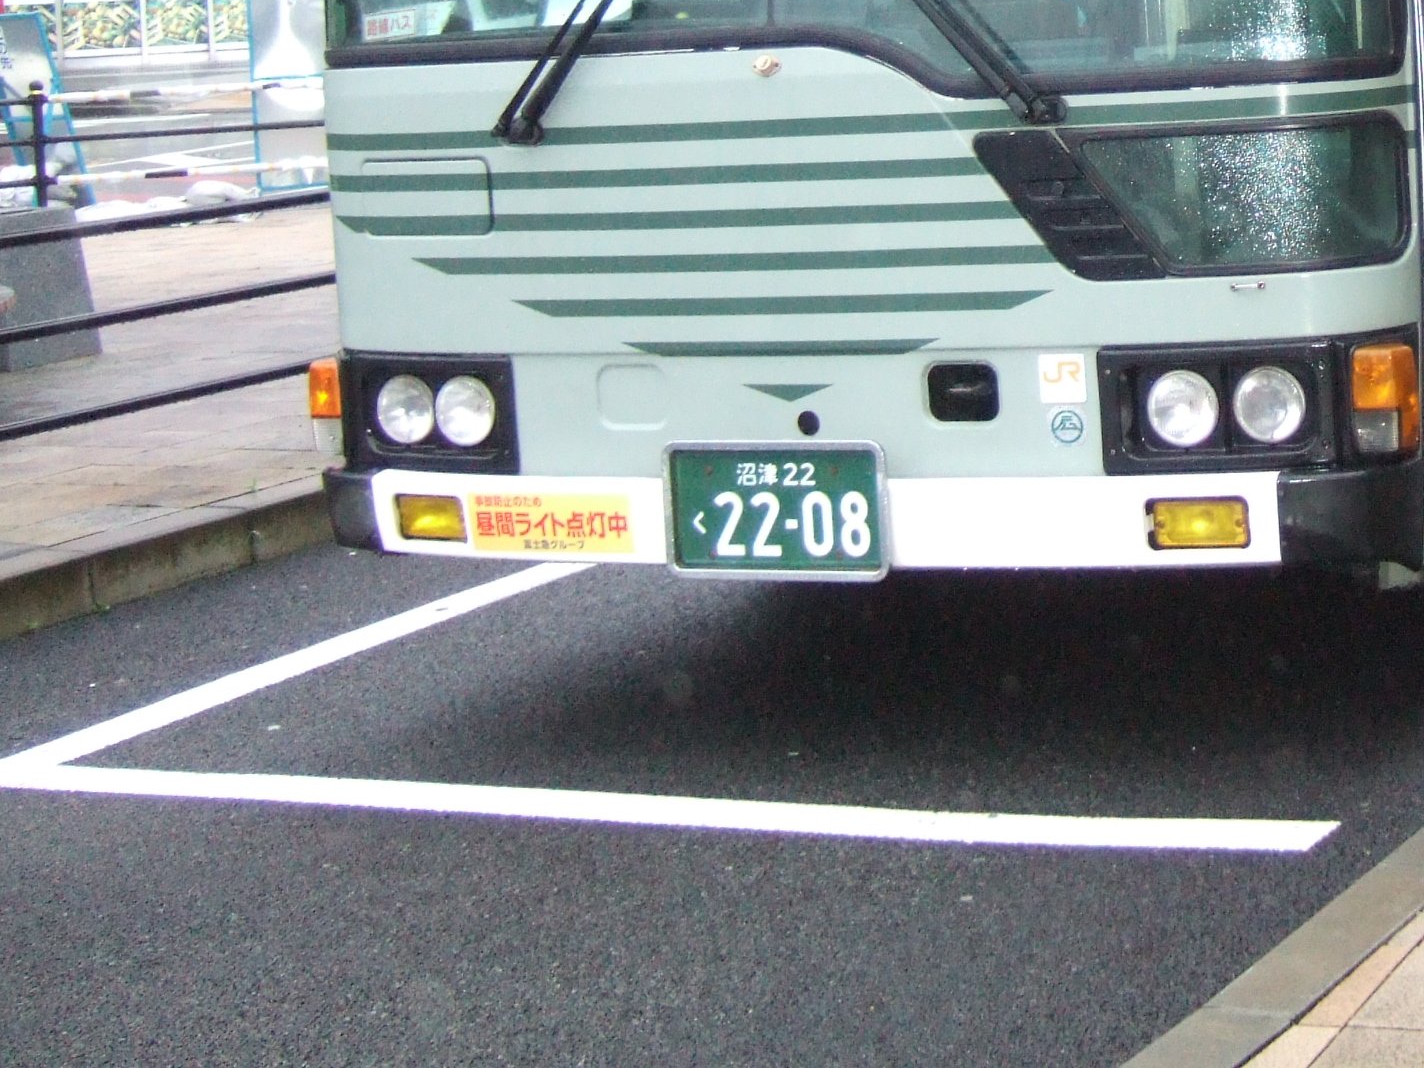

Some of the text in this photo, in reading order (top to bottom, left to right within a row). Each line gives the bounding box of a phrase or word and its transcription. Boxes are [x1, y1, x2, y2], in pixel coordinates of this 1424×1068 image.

[1043, 361, 1081, 383] JR
[475, 510, 629, 539] 昼間ライト点灯中
